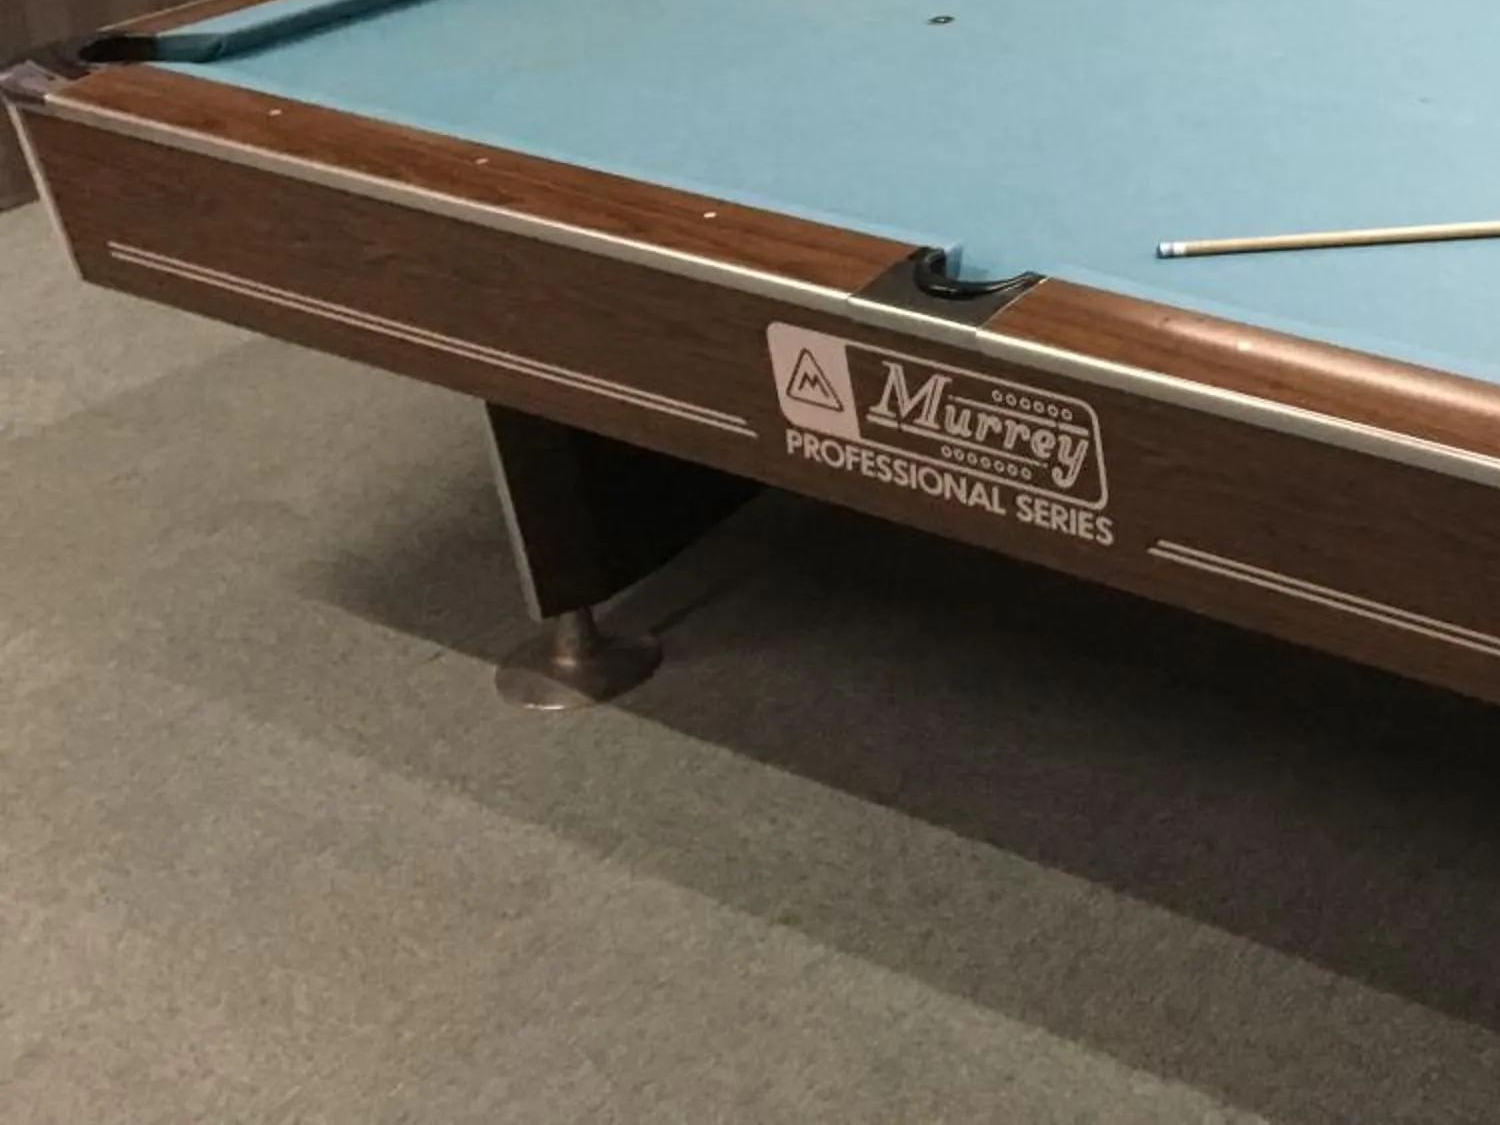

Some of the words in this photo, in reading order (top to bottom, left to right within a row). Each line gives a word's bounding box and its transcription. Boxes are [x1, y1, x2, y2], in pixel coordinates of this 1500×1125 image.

[868, 360, 1089, 489] Murrey
[785, 428, 1007, 516] PROFESSIONAL
[1015, 495, 1115, 547] SERIES
